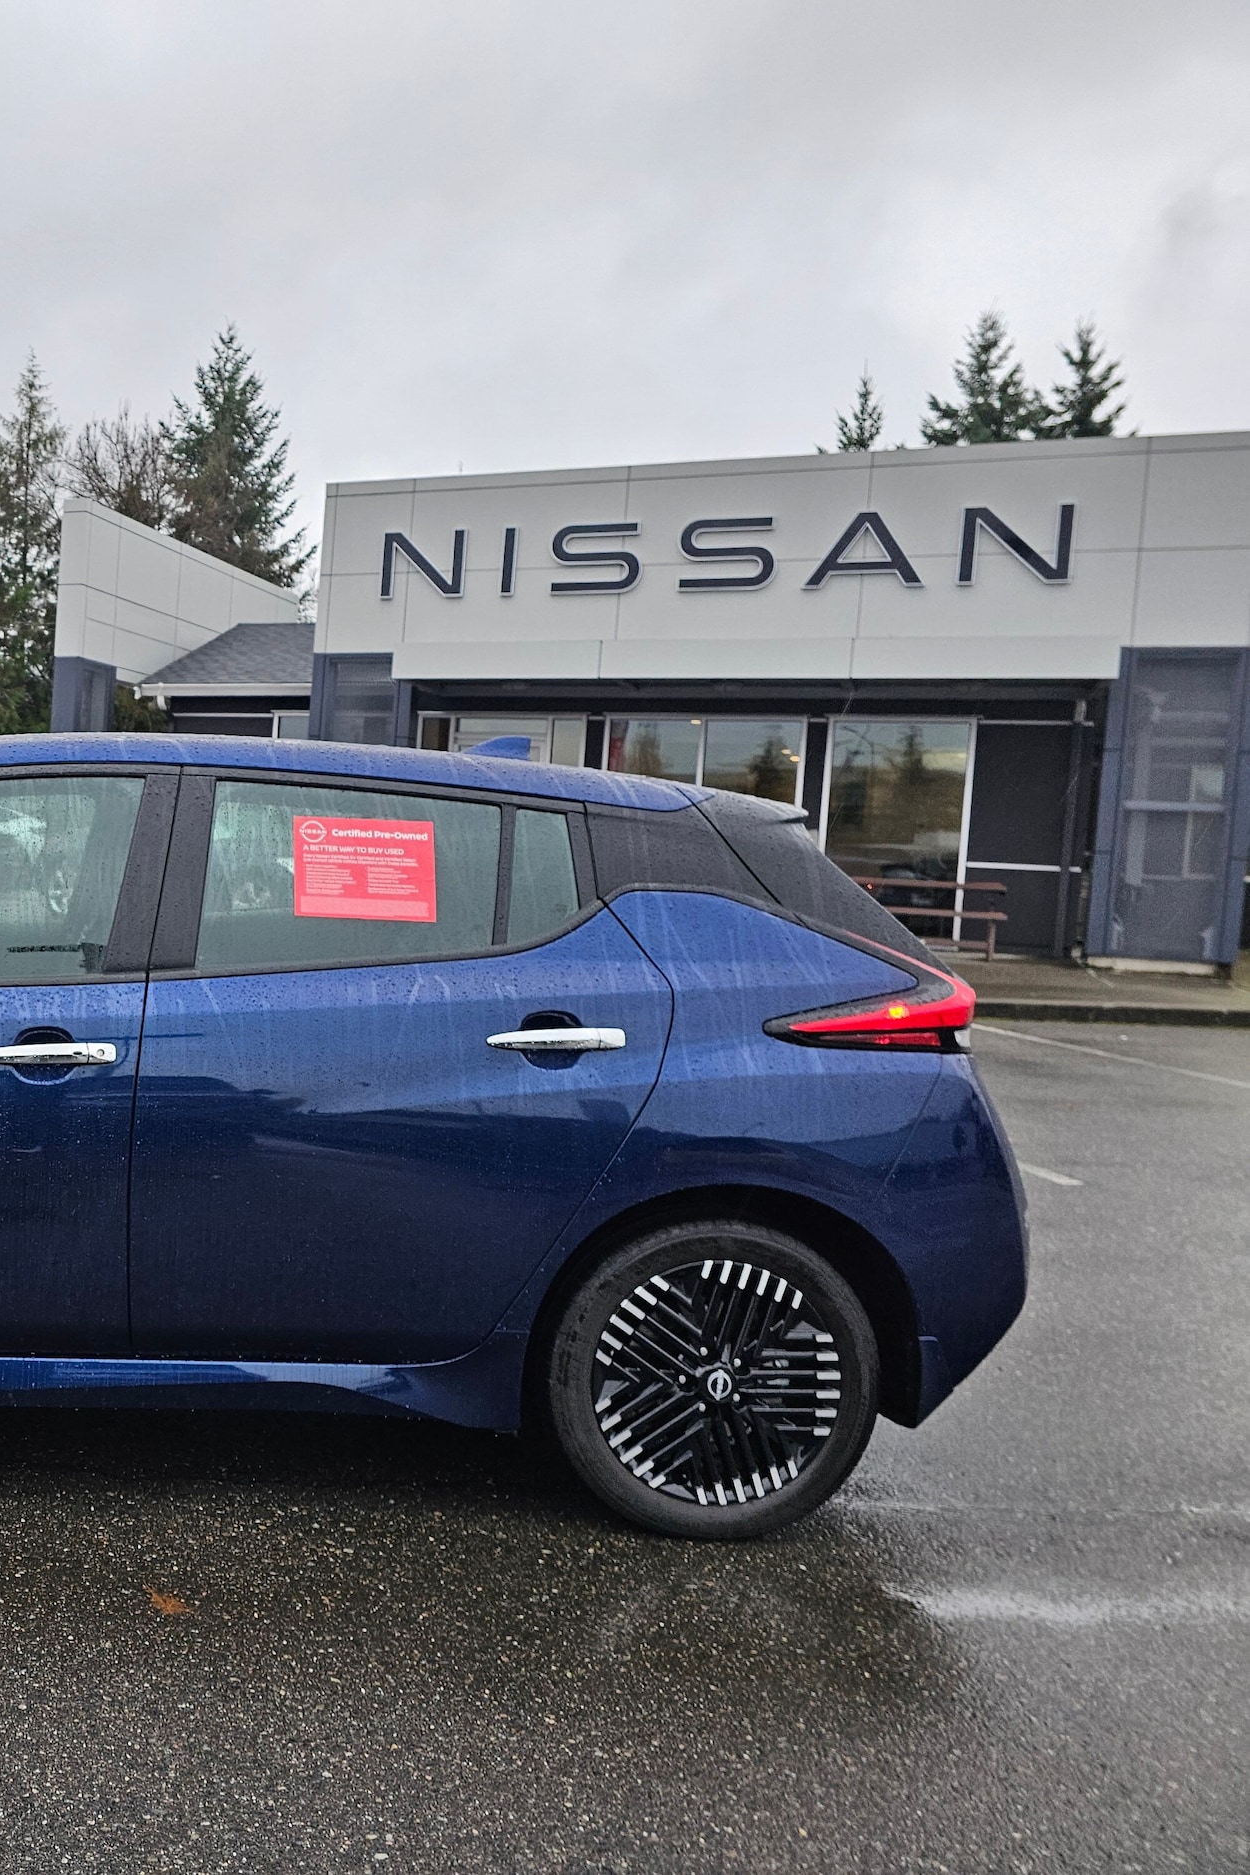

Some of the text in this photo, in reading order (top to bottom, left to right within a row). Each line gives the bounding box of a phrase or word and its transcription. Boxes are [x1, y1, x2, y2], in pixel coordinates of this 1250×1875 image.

[380, 503, 1076, 599] NISSAN
[332, 829, 428, 841] Certified Pre-Owned
[310, 844, 339, 852] BETTER
[368, 847, 383, 855] BUY
[384, 848, 404, 856] USED
